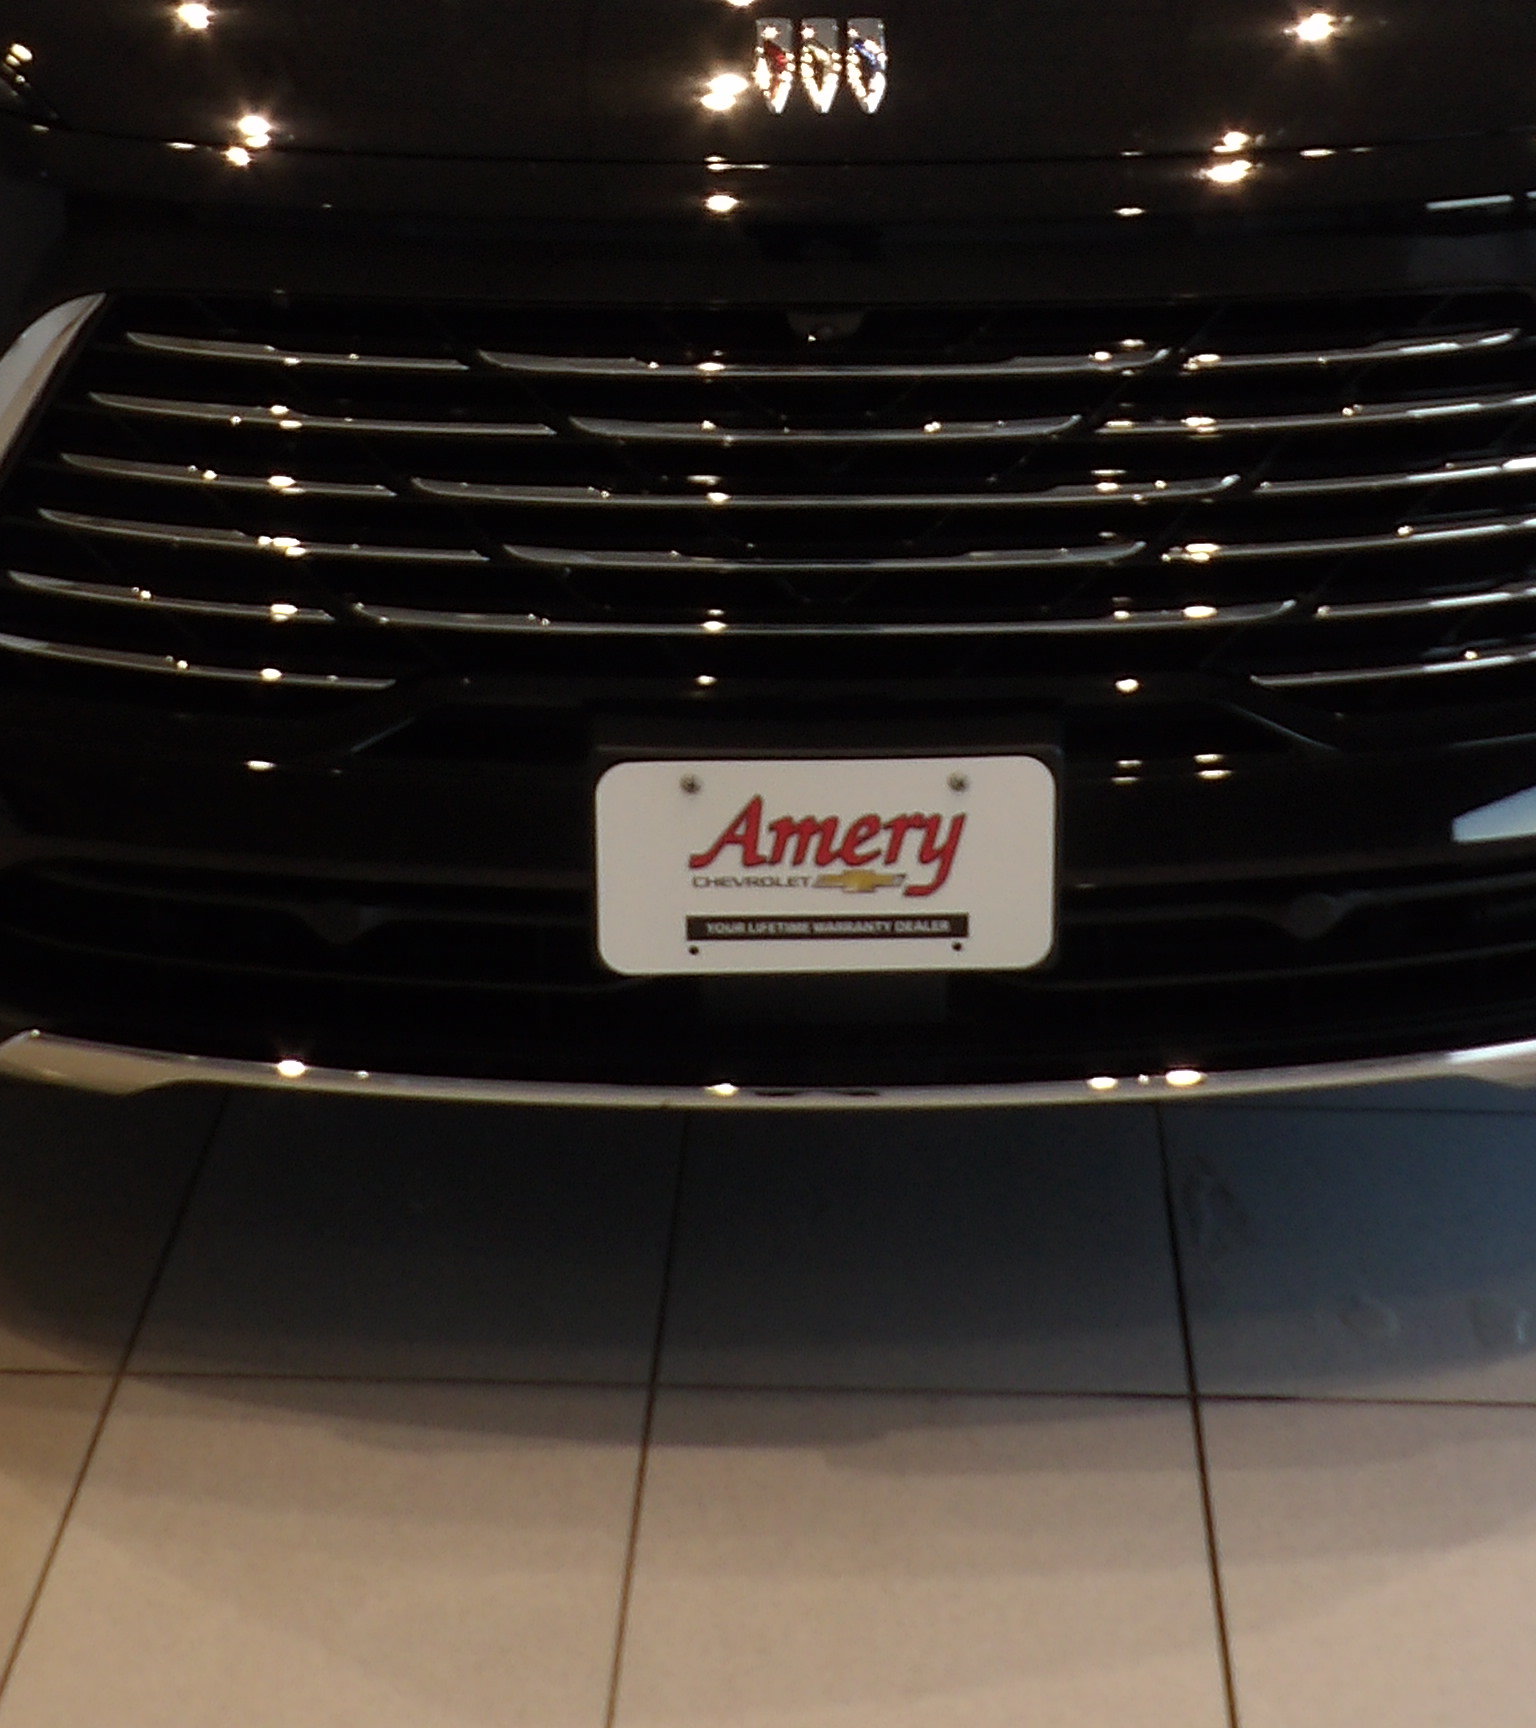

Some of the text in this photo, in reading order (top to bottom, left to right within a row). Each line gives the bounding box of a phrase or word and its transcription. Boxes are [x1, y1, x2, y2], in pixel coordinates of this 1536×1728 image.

[688, 793, 966, 897] Amery
[692, 875, 812, 888] CHEVROLET
[706, 919, 950, 934] YOUR LIFETIME WARRANTY DEALER
